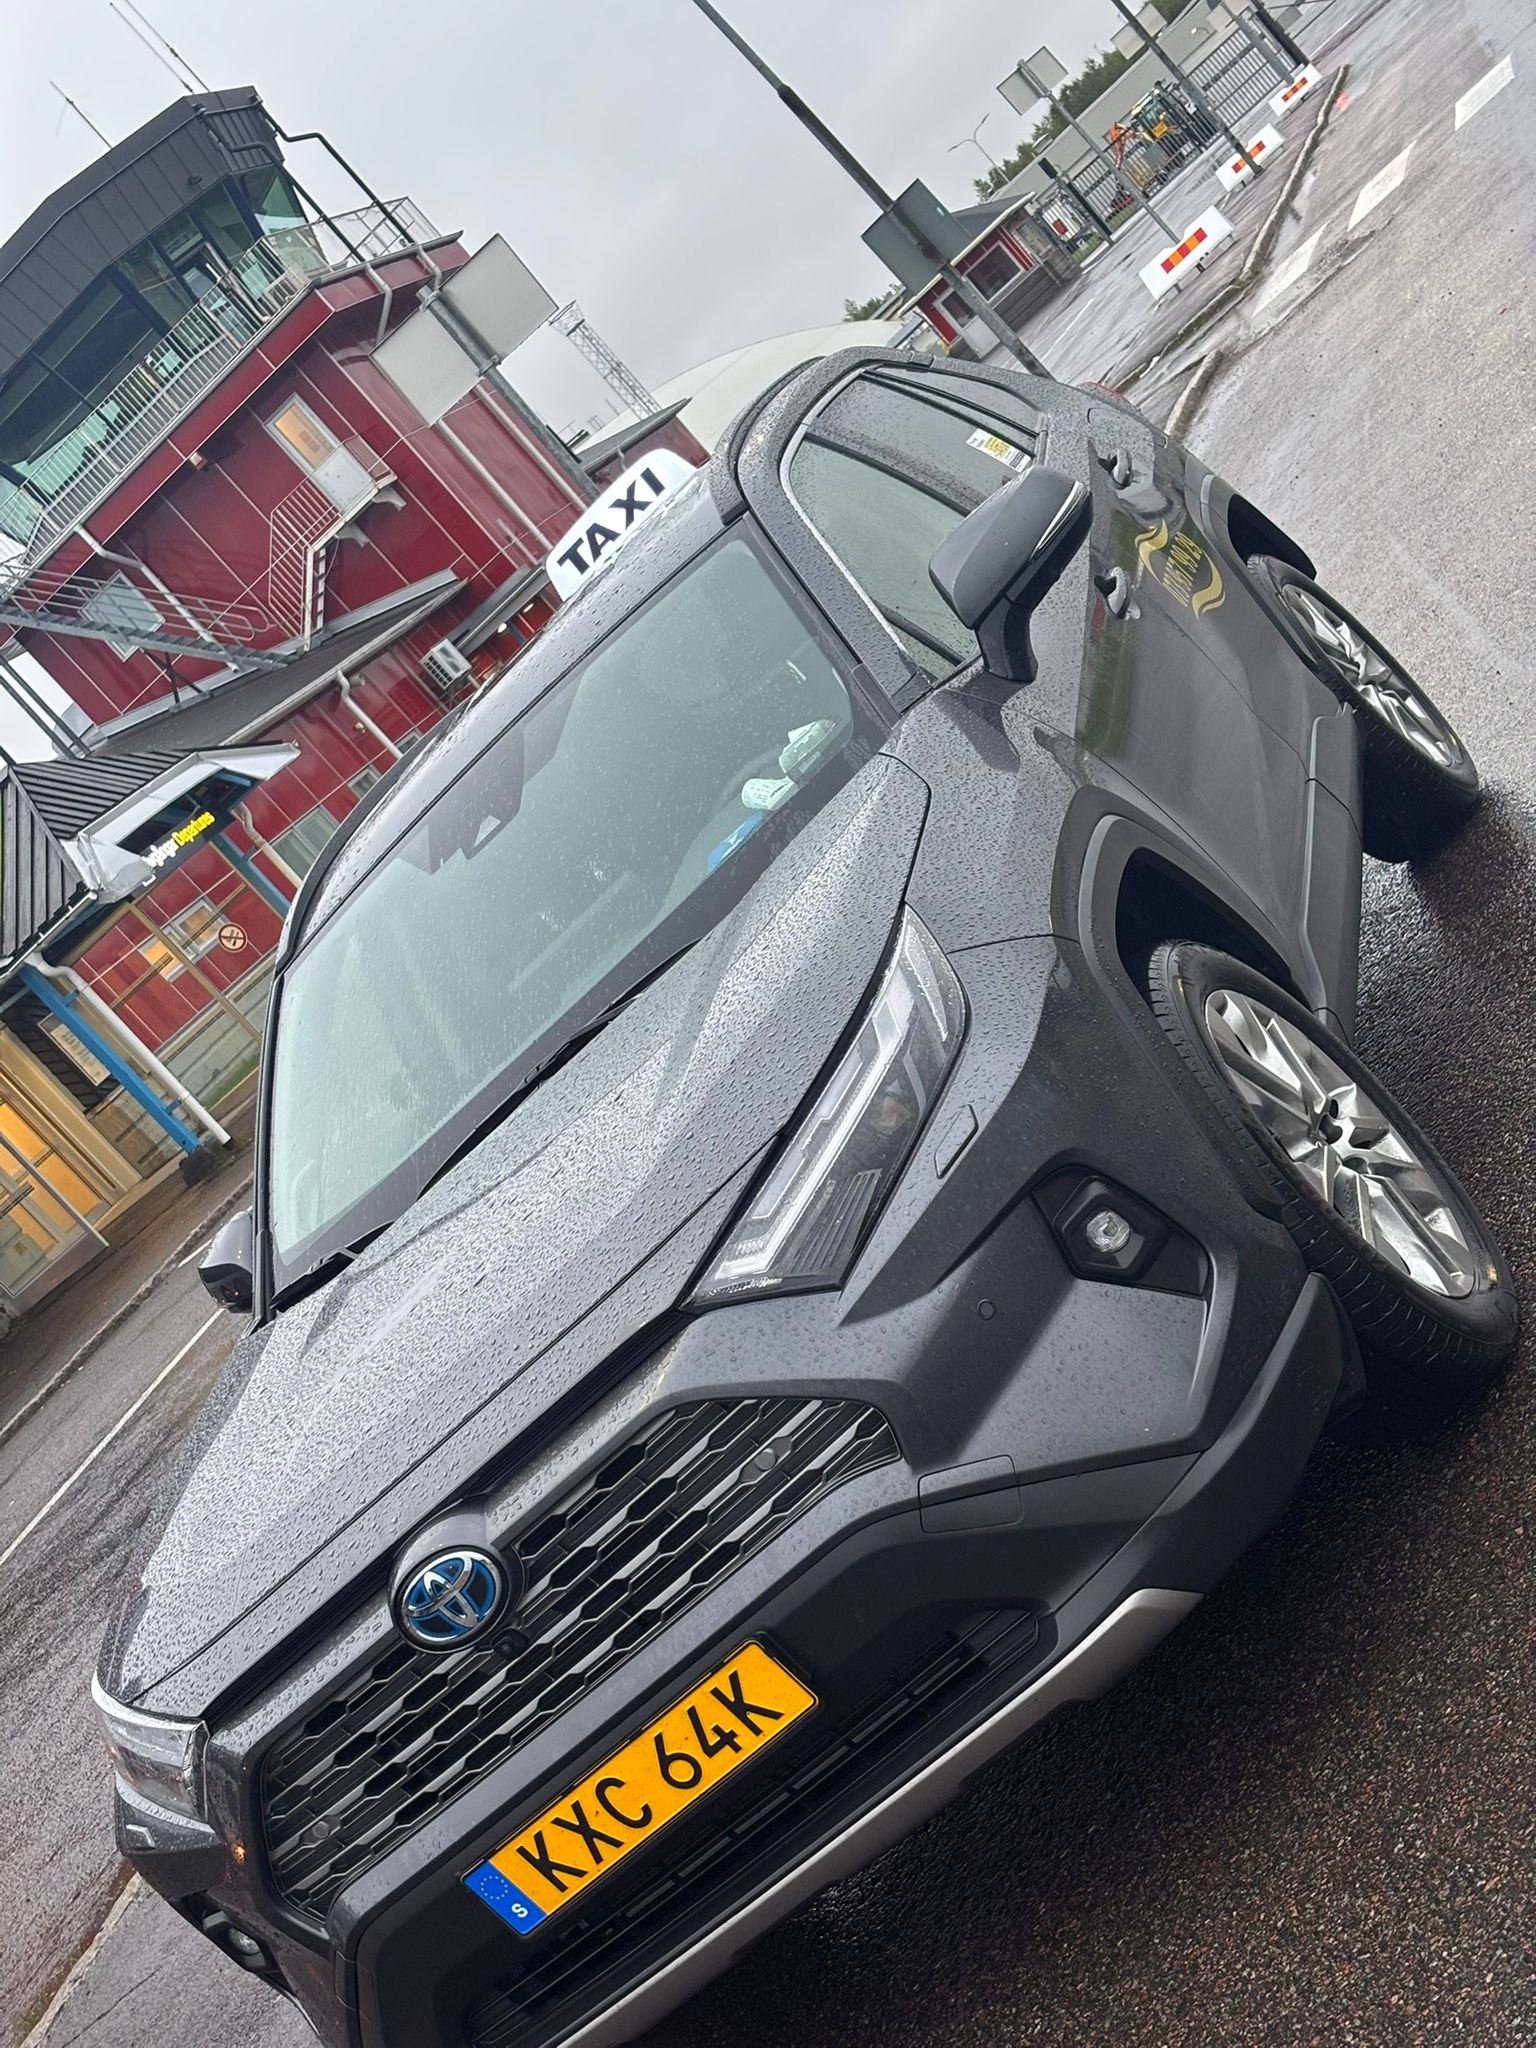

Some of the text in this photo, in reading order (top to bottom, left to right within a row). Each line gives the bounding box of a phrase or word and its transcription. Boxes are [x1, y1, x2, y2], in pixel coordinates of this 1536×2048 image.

[557, 467, 666, 576] TAXI
[171, 811, 216, 847] Departures
[516, 1669, 785, 1893] KXC 64K
[511, 1902, 529, 1919] S
